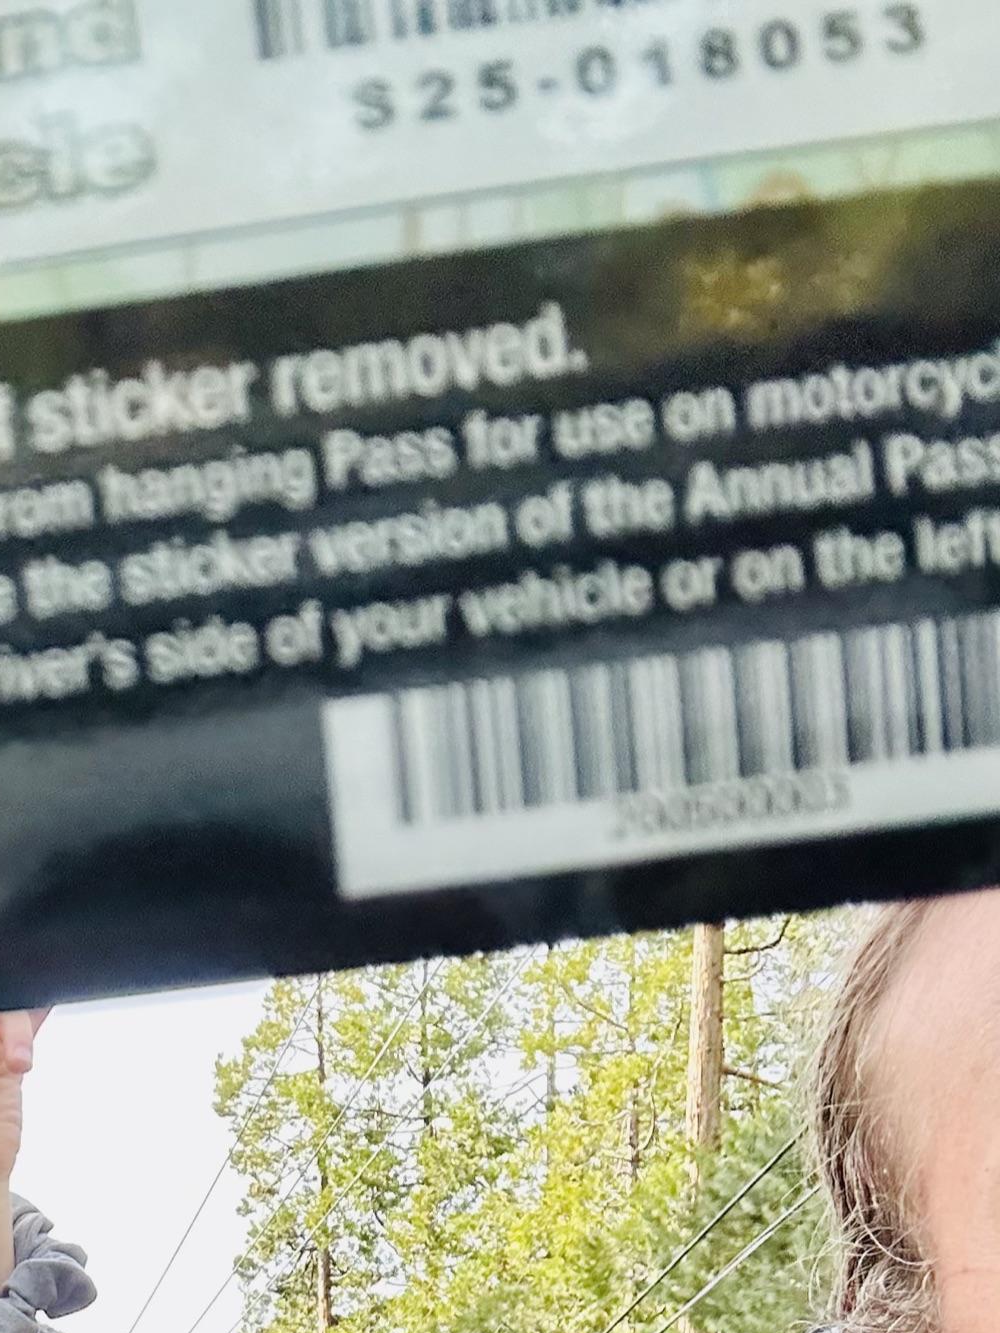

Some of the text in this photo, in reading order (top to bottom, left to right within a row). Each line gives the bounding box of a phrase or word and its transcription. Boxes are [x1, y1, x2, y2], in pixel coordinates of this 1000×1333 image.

[351, 4, 928, 130] S25-018053
[27, 359, 258, 454] sticker
[269, 301, 588, 419] removed.
[99, 443, 317, 525] hanging
[320, 427, 458, 491] Pass
[462, 407, 542, 472] for
[550, 394, 656, 460] use
[661, 384, 736, 444] on
[745, 337, 1000, 430] motorcyc
[20, 552, 113, 622] the
[118, 527, 300, 607] sticker
[308, 498, 509, 578] version
[515, 477, 574, 549] of
[582, 473, 674, 539] the
[685, 436, 876, 524] Annual
[144, 613, 259, 685] side
[263, 596, 324, 668] of
[329, 590, 451, 669] your
[459, 555, 654, 637] vehicle
[659, 552, 723, 612] or
[731, 541, 804, 602] on
[813, 524, 905, 591] the
